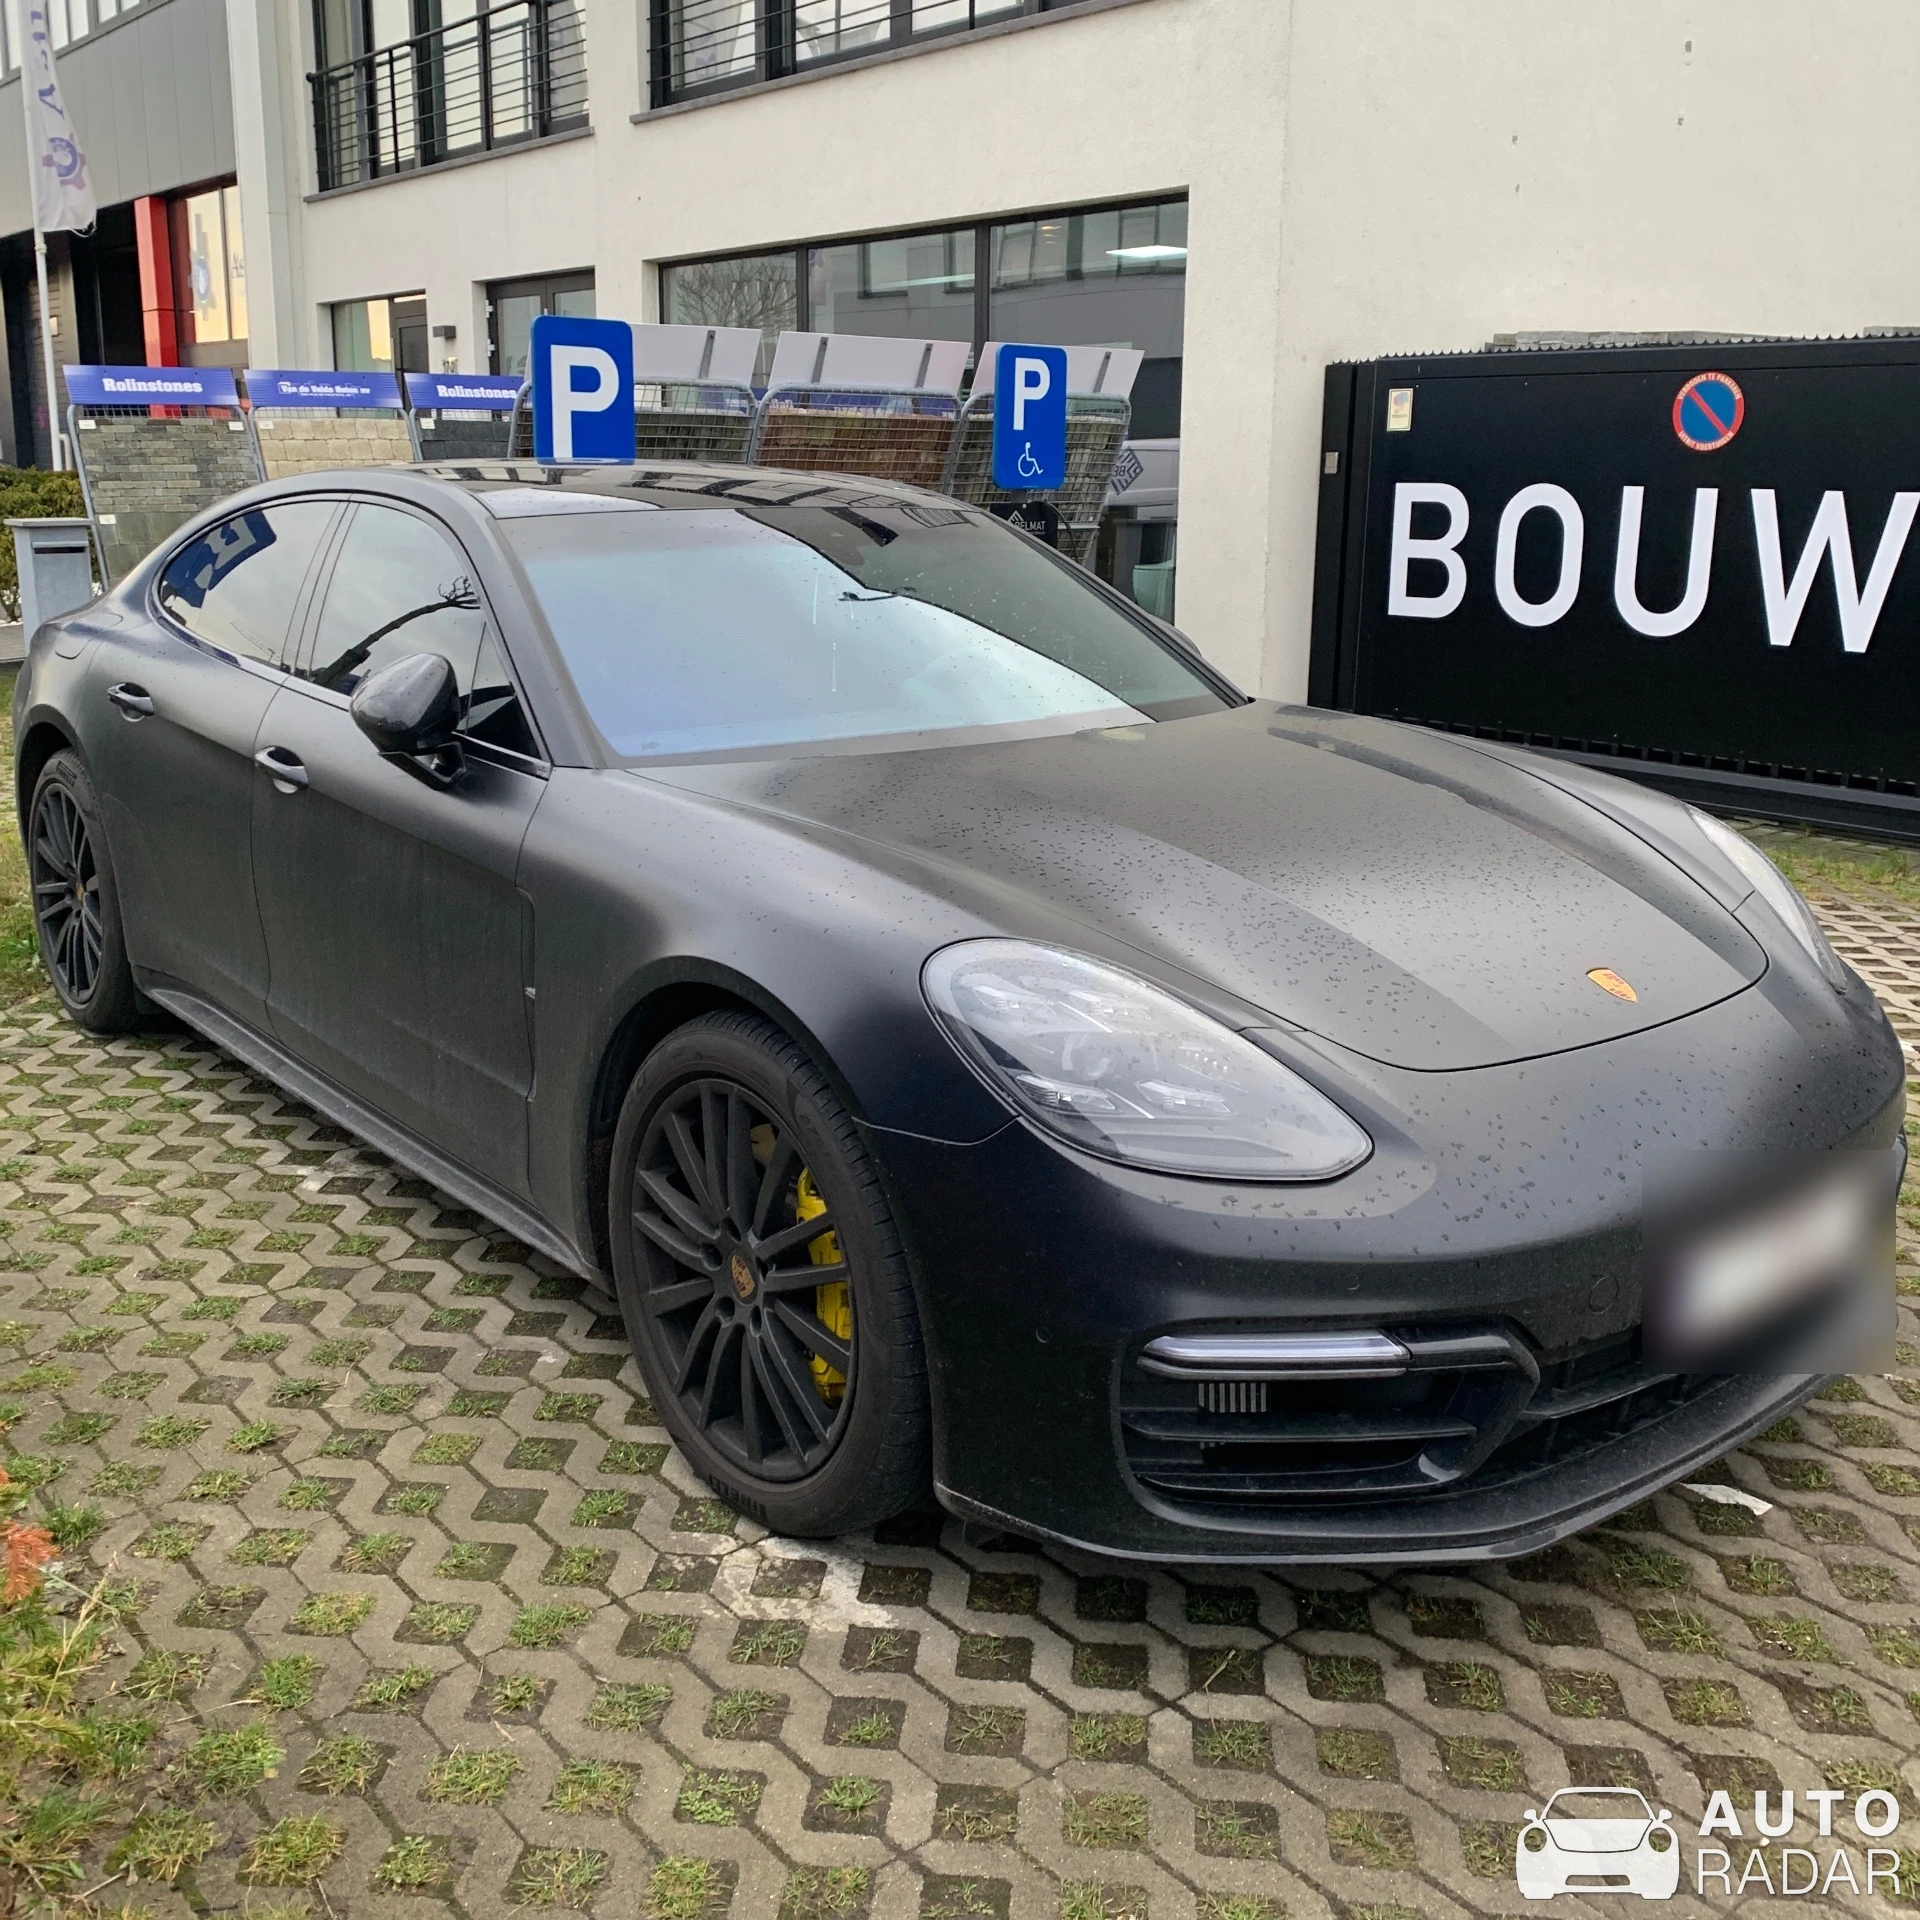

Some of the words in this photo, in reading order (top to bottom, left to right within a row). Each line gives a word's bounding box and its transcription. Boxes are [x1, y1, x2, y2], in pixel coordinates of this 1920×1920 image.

[102, 378, 203, 393] Rolinstones
[436, 384, 518, 399] Rolinstones
[550, 344, 619, 459] P
[1013, 357, 1051, 431] P
[1677, 373, 1707, 400] VERBODEN
[1388, 482, 1920, 653] BOUW
